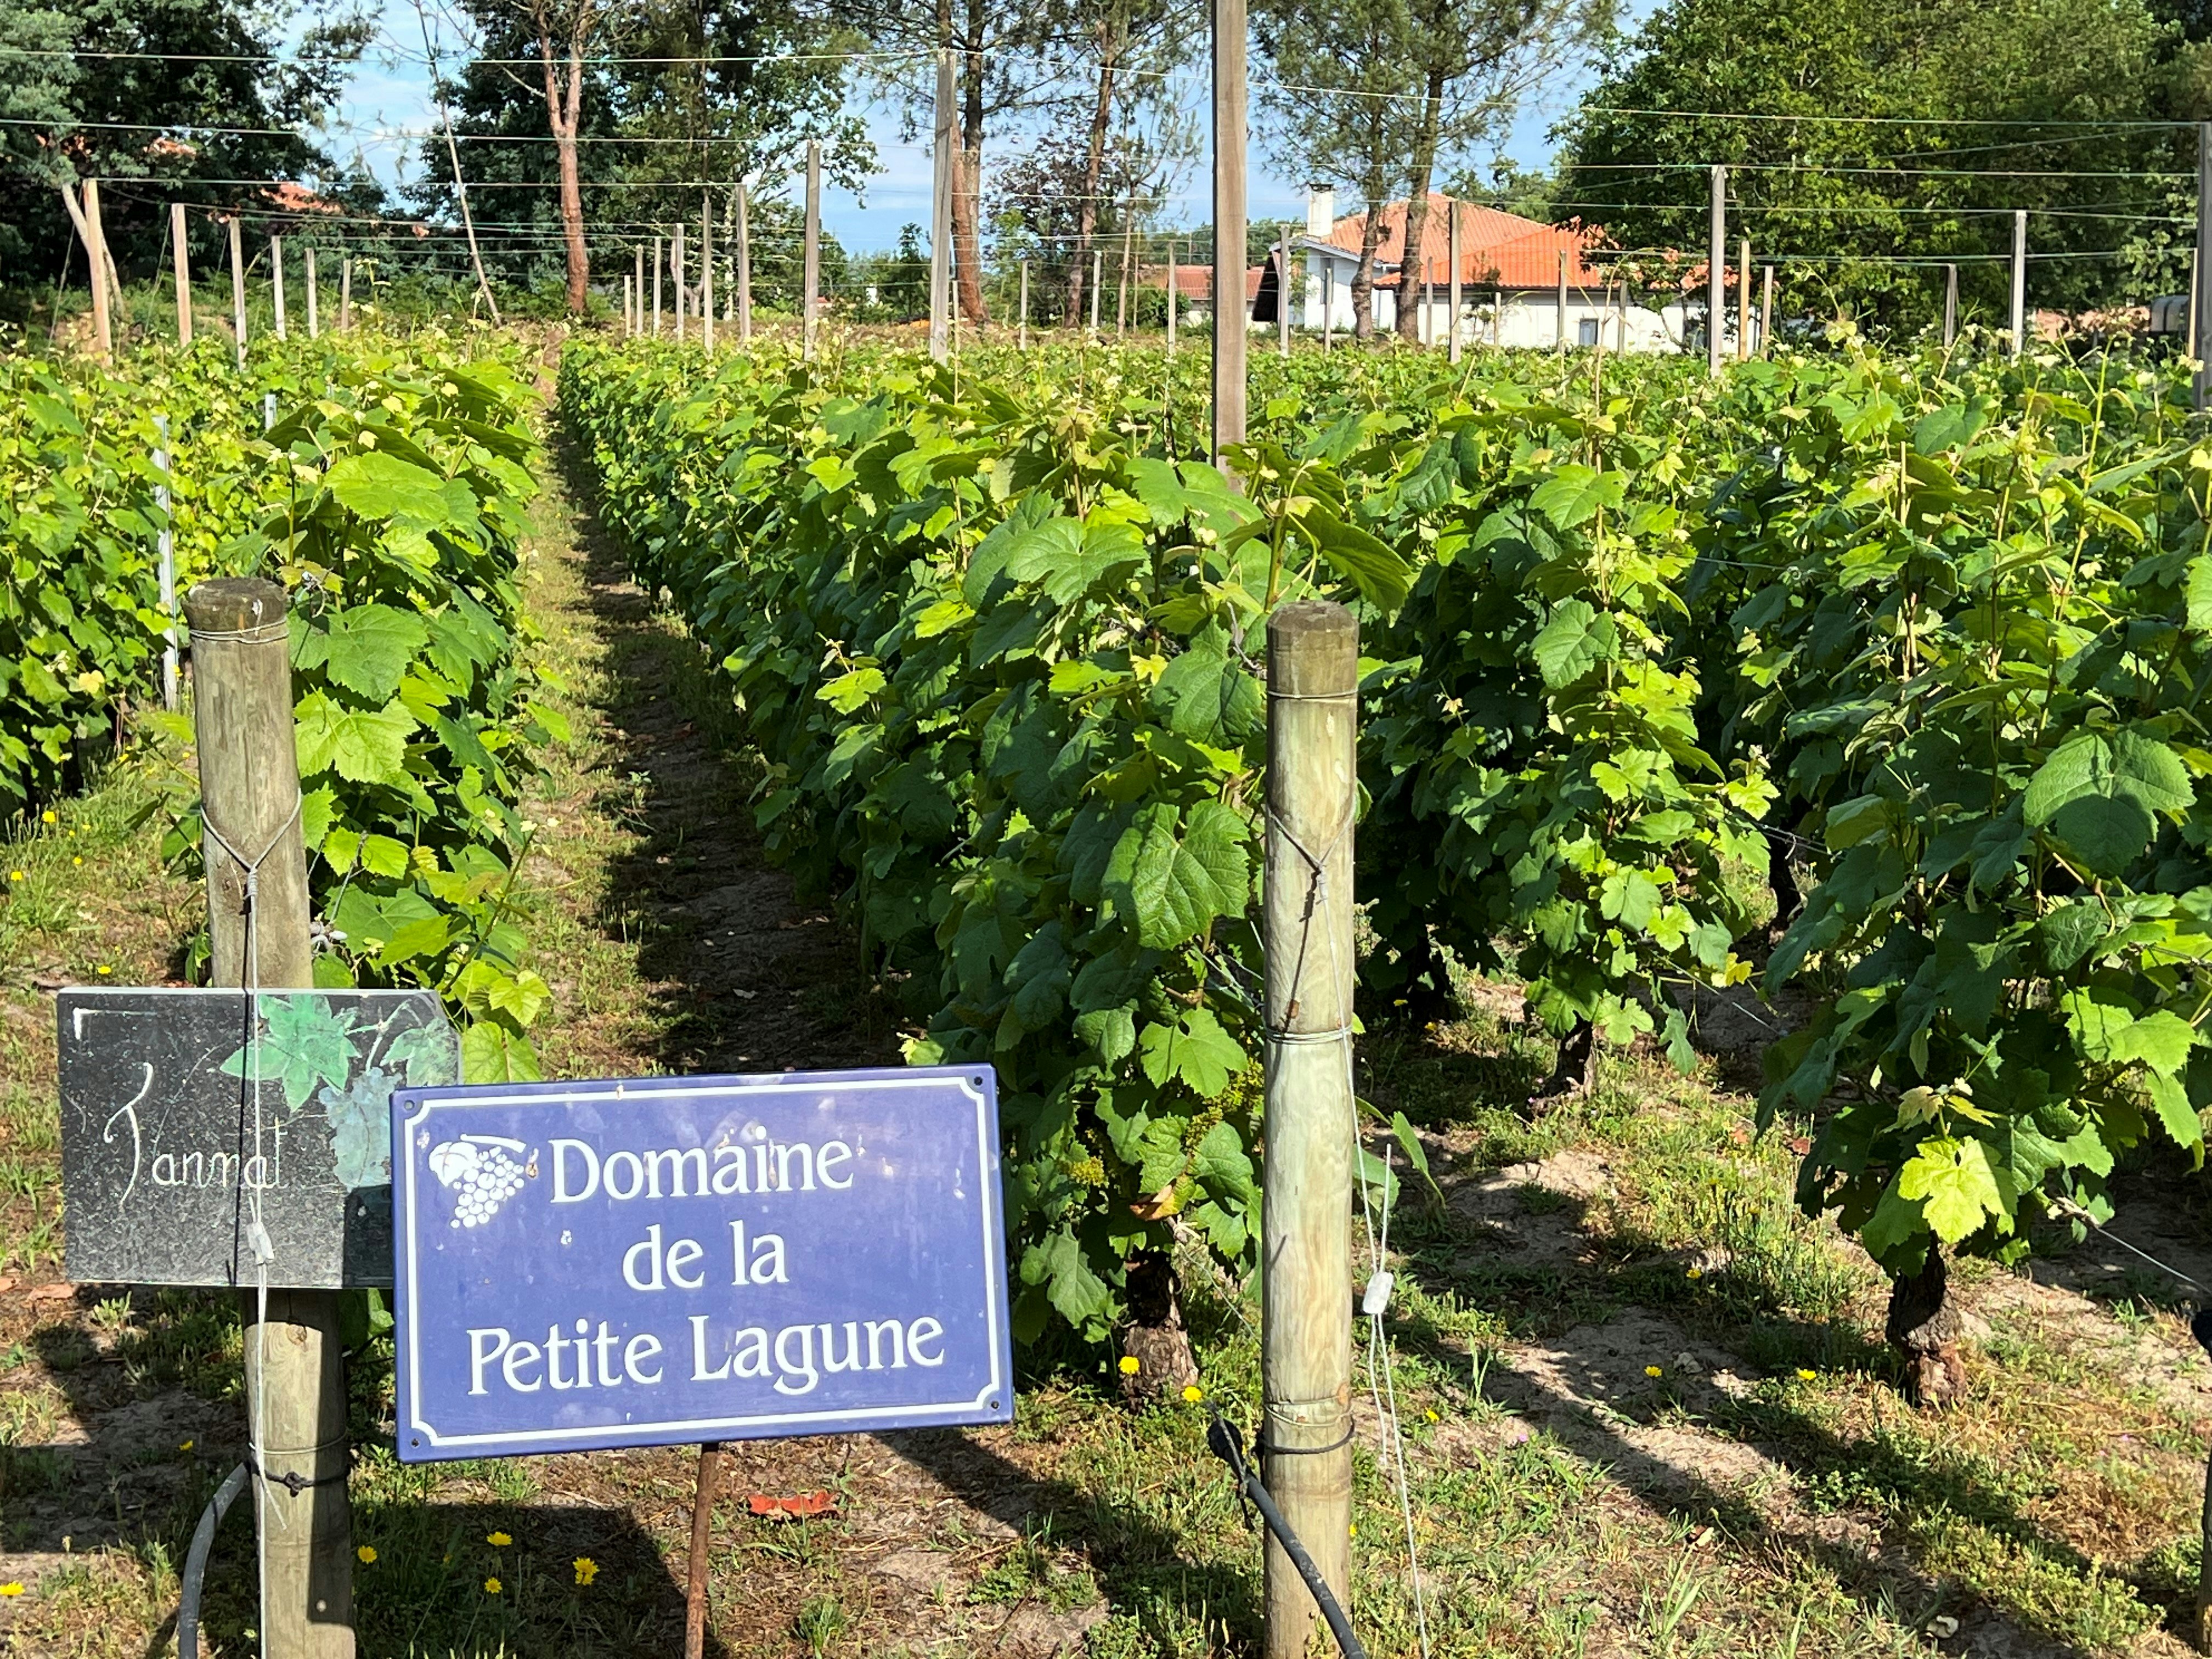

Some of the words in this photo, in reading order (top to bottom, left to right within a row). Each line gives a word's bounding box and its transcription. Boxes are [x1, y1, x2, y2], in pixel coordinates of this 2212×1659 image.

[103, 1062, 287, 1209] Tannat
[549, 1126, 854, 1204] Domaine
[623, 1223, 704, 1291] de
[729, 1220, 789, 1286] la
[466, 1318, 663, 1396] Petite
[688, 1314, 945, 1396] Lagune
